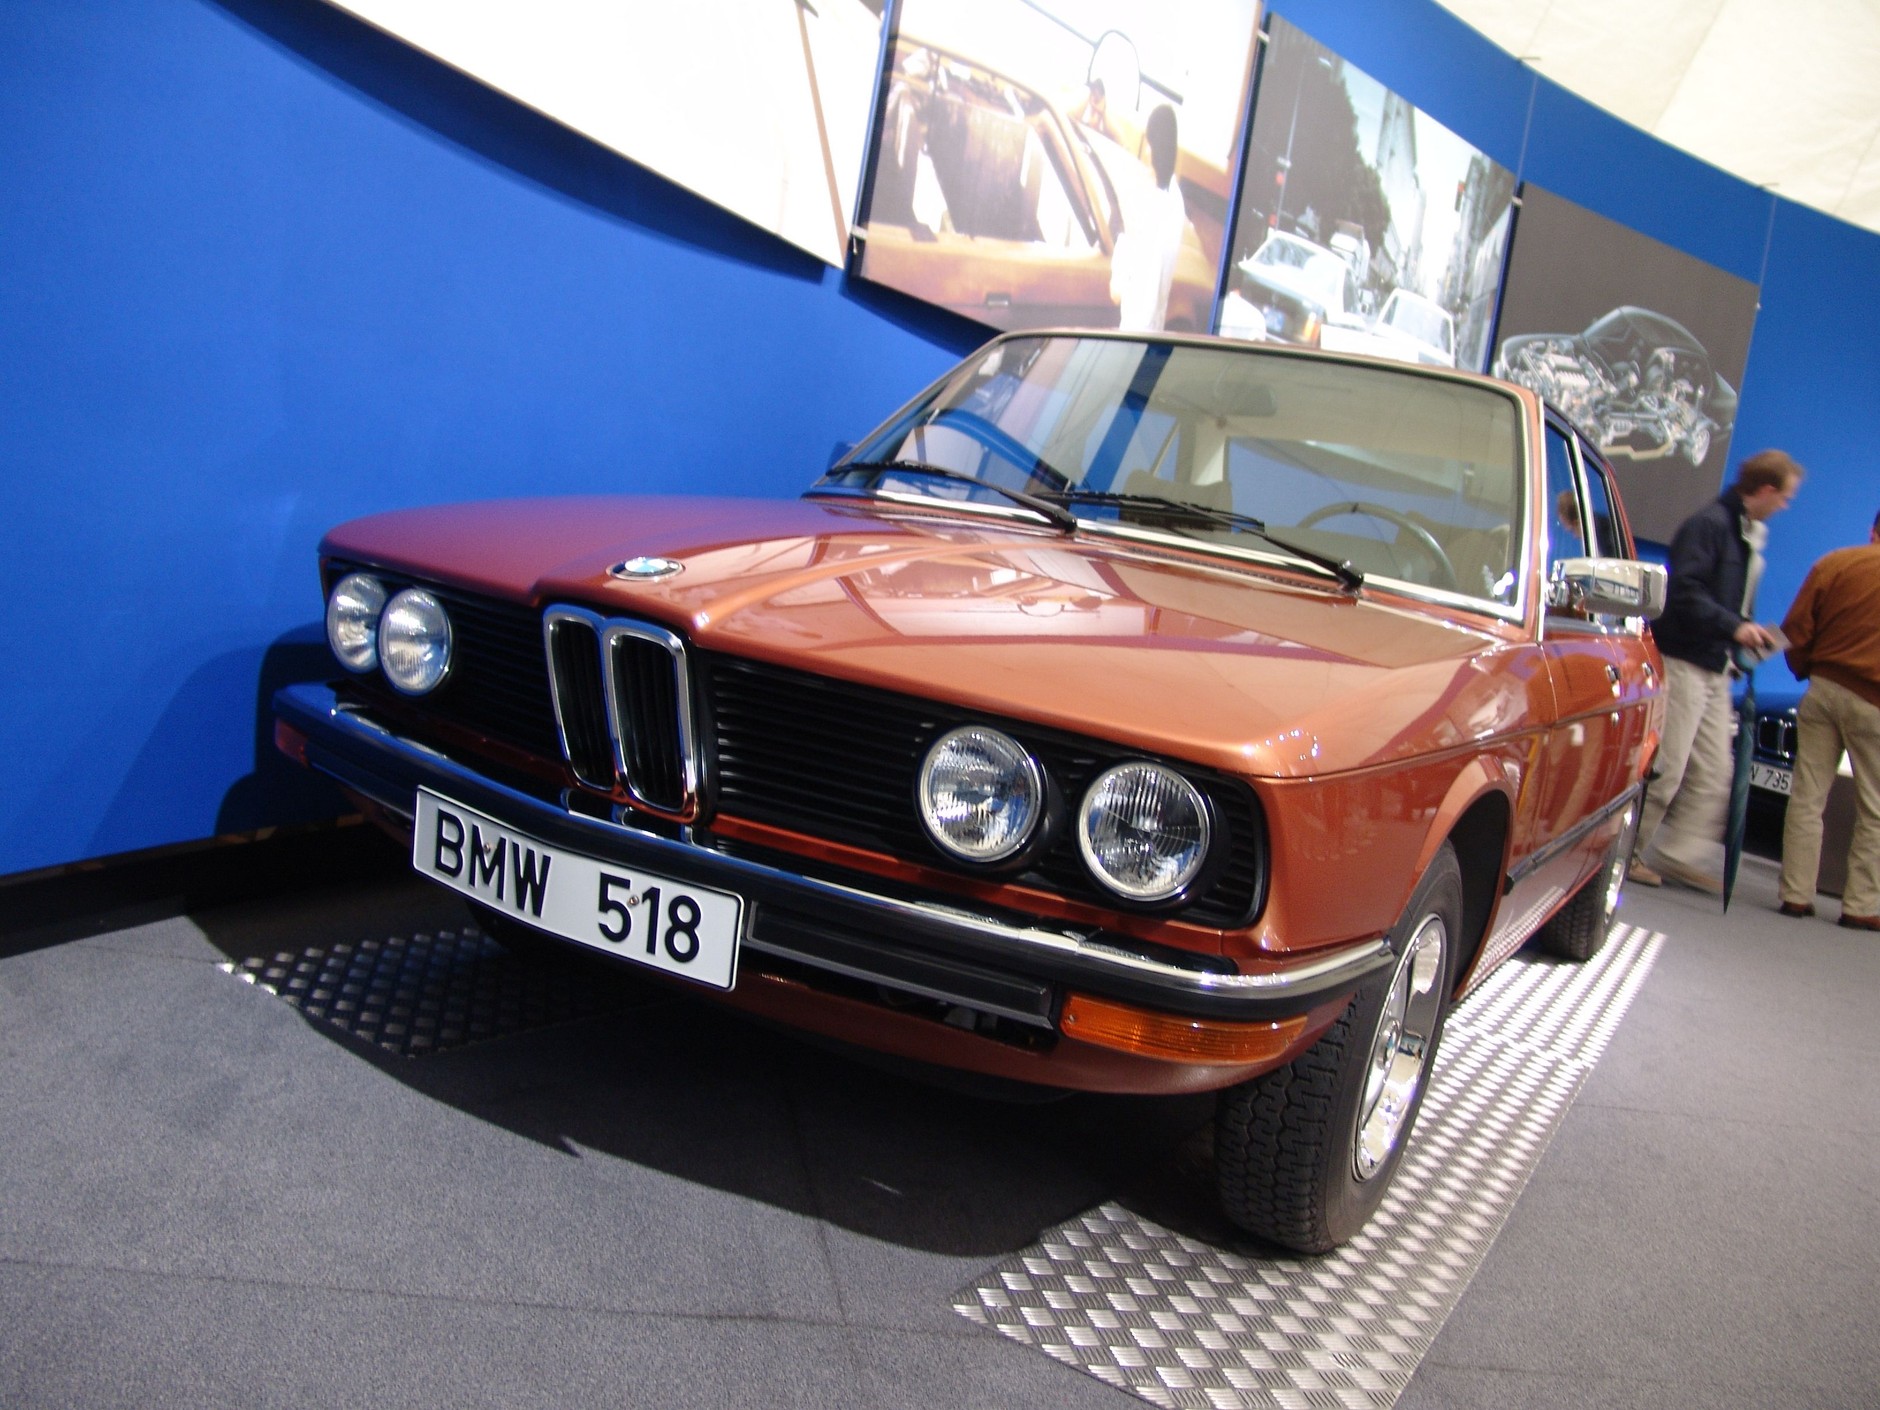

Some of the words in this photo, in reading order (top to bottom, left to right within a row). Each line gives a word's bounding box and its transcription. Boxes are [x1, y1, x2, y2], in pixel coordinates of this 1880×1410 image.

[1764, 769, 1790, 790] 735
[435, 808, 552, 918] BMW
[598, 871, 702, 963] 518
